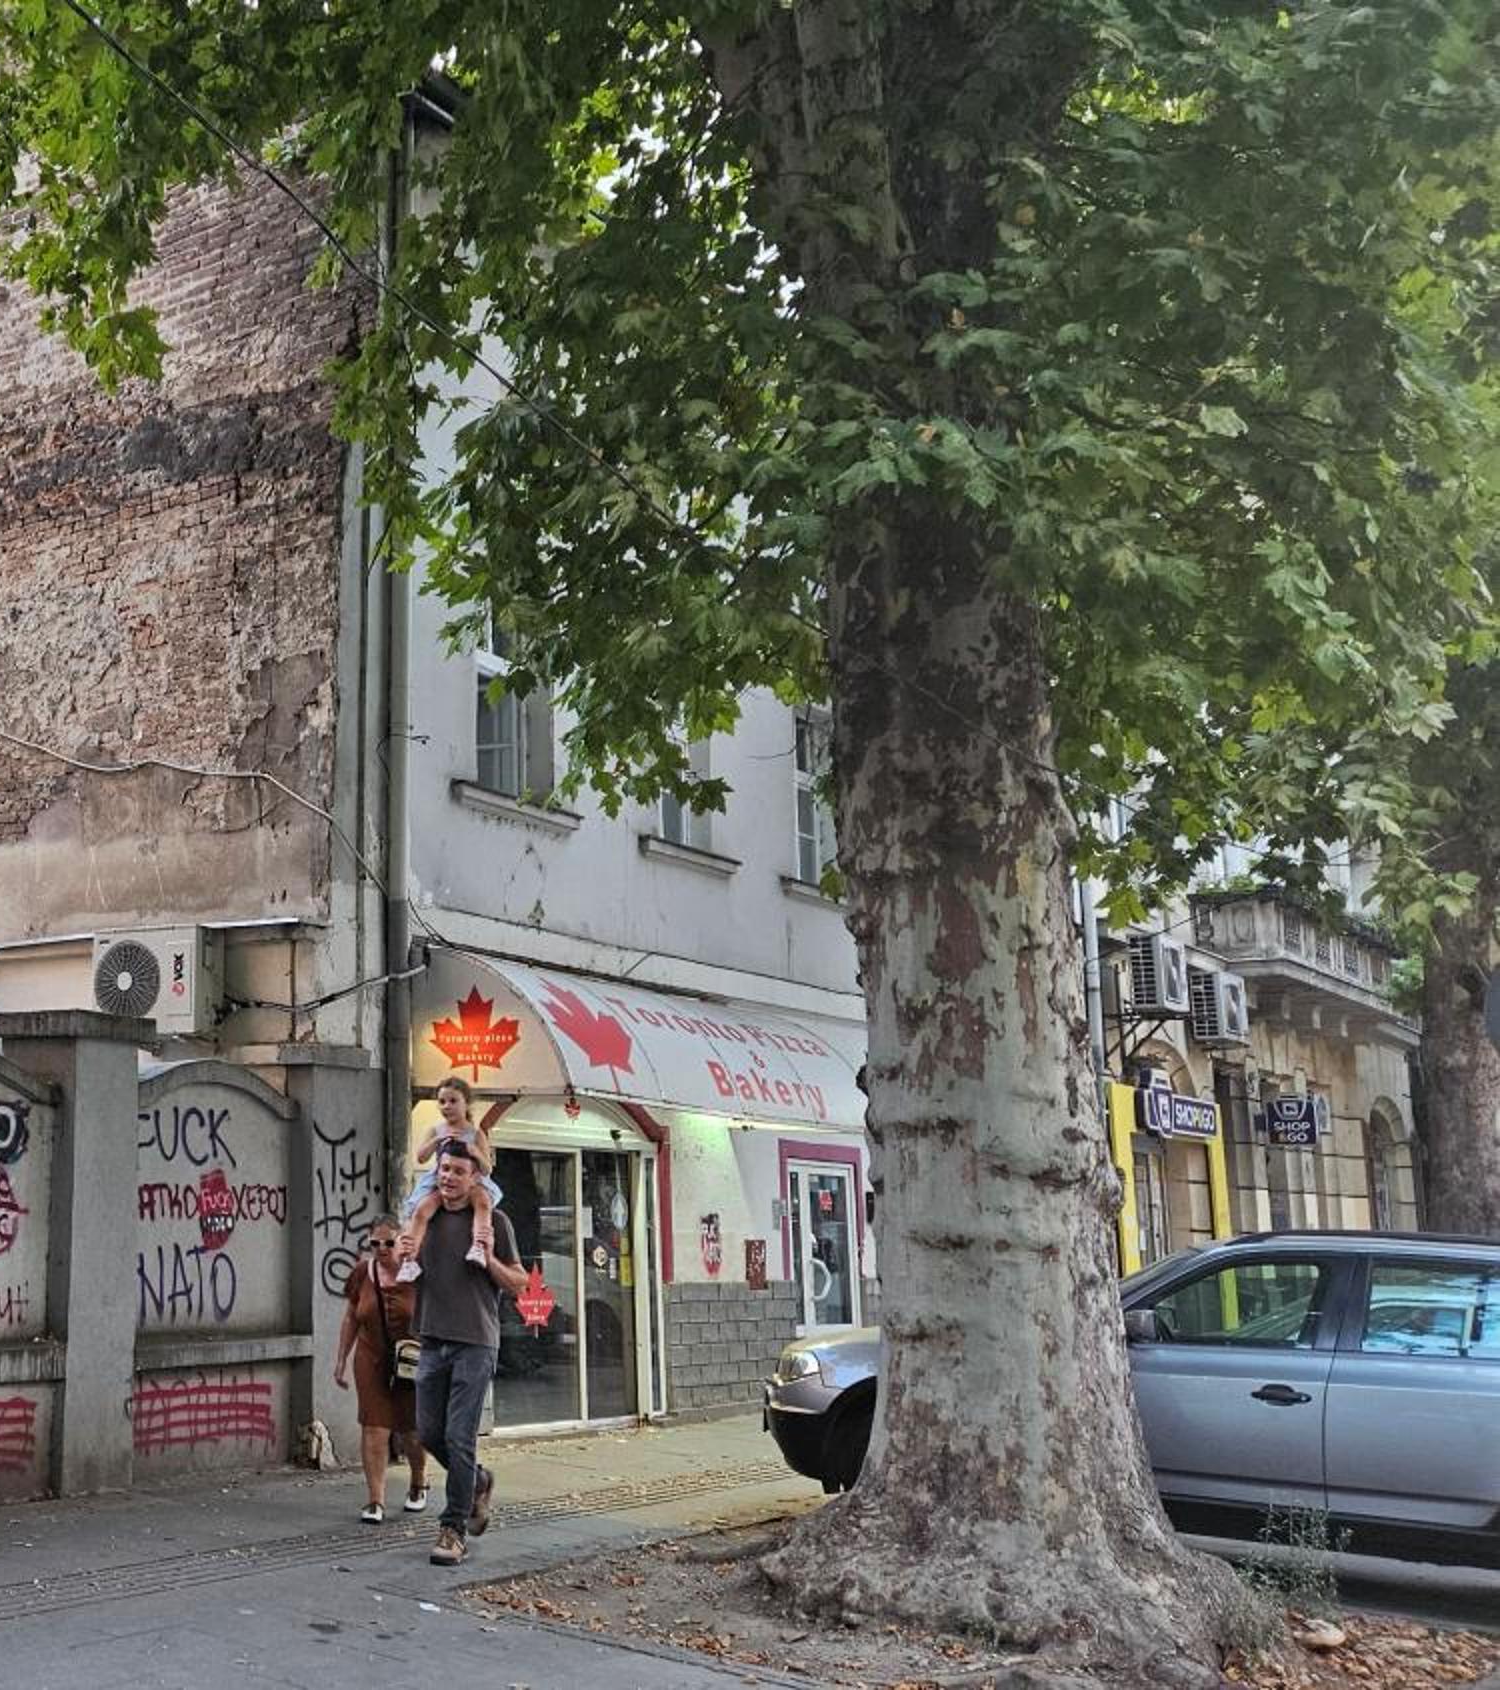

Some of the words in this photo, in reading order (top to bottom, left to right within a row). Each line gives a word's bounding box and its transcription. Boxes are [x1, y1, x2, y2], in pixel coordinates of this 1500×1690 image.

[174, 952, 184, 981] VOX
[605, 996, 746, 1044] Toronto
[738, 1023, 829, 1057] Pizza
[706, 1059, 827, 1120] Bakery
[1273, 1121, 1310, 1131] SHOP
[137, 1243, 236, 1326] NATO
